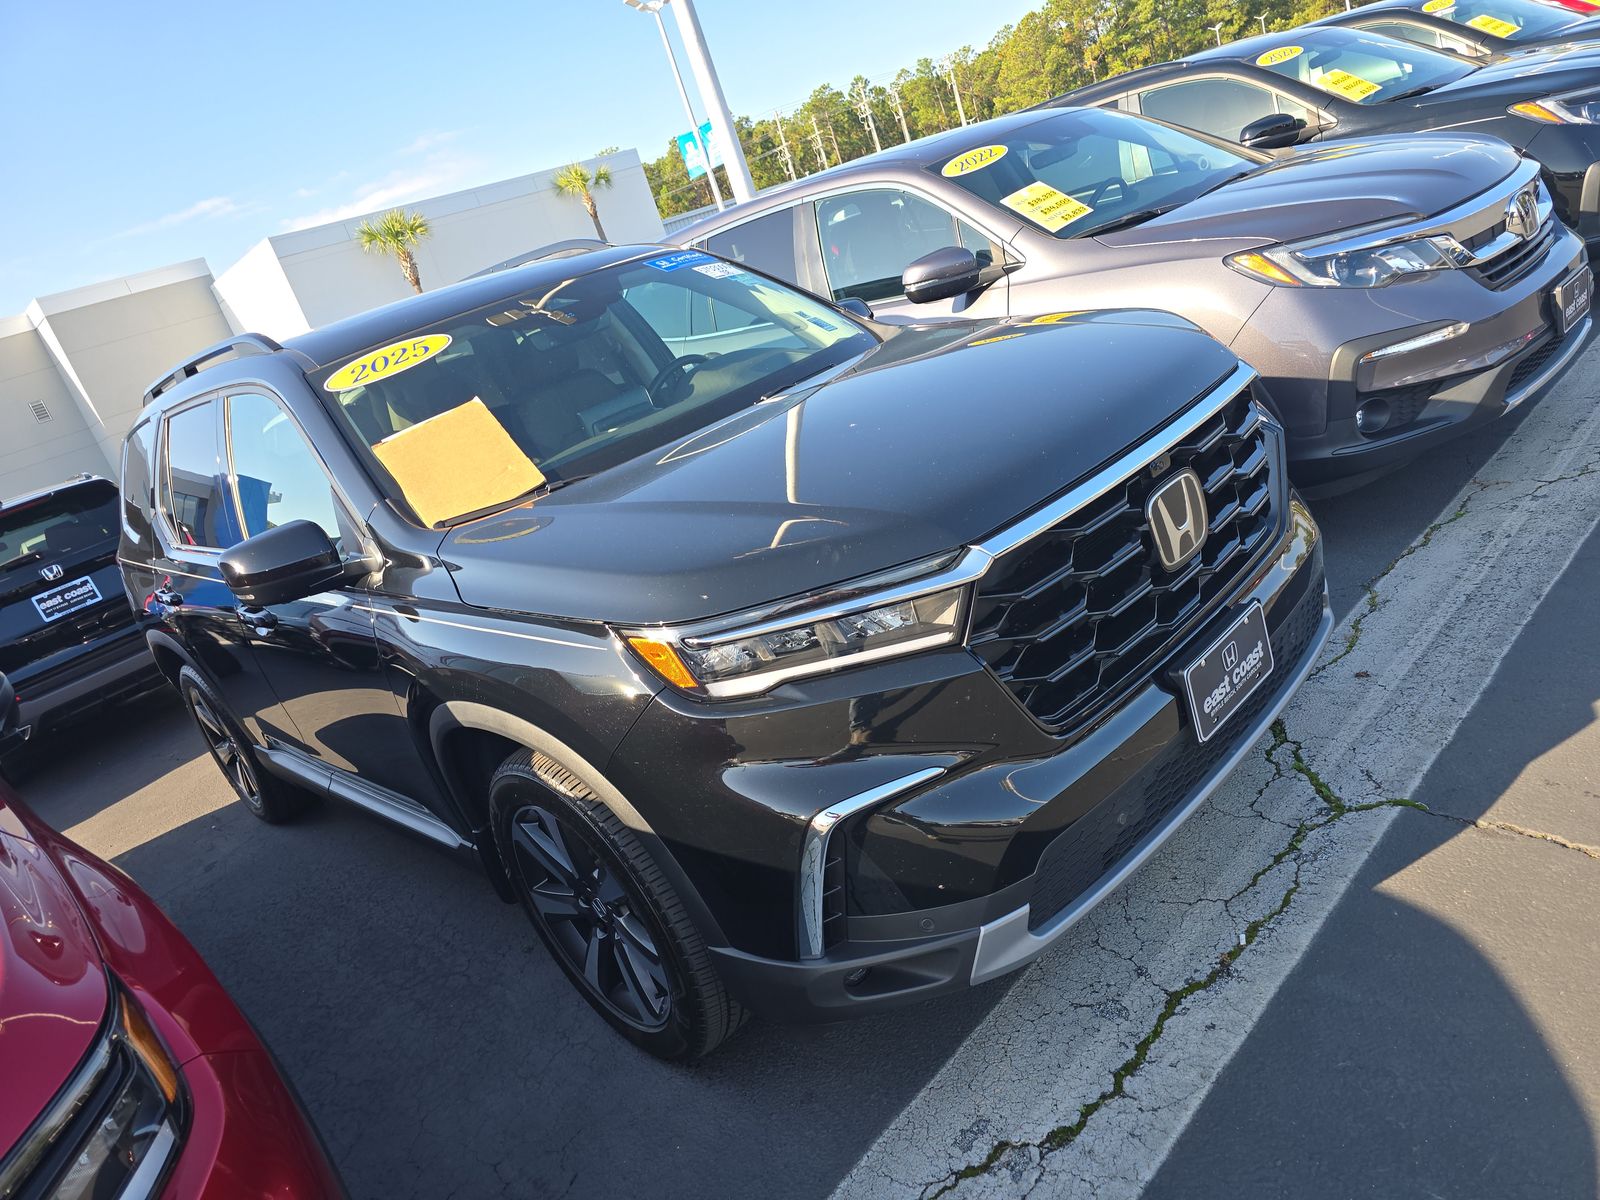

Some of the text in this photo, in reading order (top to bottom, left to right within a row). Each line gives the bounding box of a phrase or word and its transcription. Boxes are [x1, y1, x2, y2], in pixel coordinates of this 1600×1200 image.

[955, 149, 998, 171] 2022
[351, 340, 429, 384] 2025
[40, 595, 63, 610] east
[64, 583, 93, 600] coast
[1204, 640, 1264, 714] east coast
